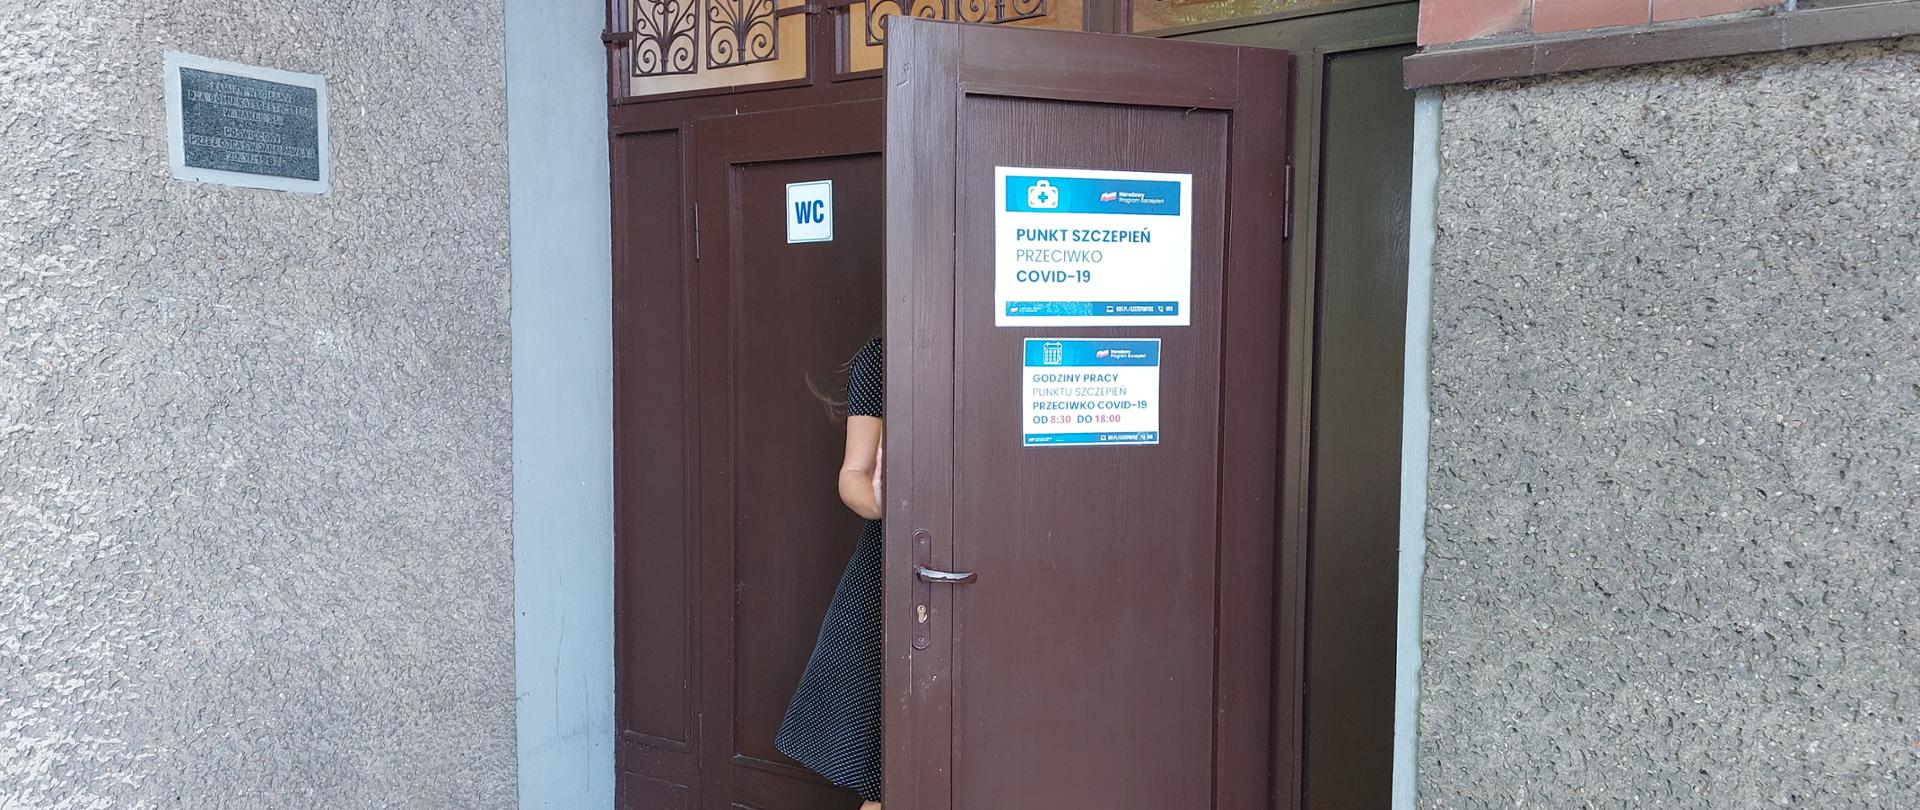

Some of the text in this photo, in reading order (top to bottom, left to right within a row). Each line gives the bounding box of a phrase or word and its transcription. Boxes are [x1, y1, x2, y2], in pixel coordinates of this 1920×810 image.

[189, 90, 205, 100] DLA
[210, 93, 234, 104] DOMU
[795, 200, 824, 224] WC
[1016, 227, 1151, 243] PUNKT SZCZEPIEŃ
[1016, 249, 1103, 262] PRZECIWKO
[1016, 270, 1091, 283] COVID-19
[1033, 374, 1118, 383] GODZINY PRACY
[1032, 385, 1127, 397] PUNKTU SZCZEPIEŃ
[1032, 400, 1148, 410] PRZECIWKO COVID-19
[1032, 414, 1121, 424] OD 8:30 DO 18:00
